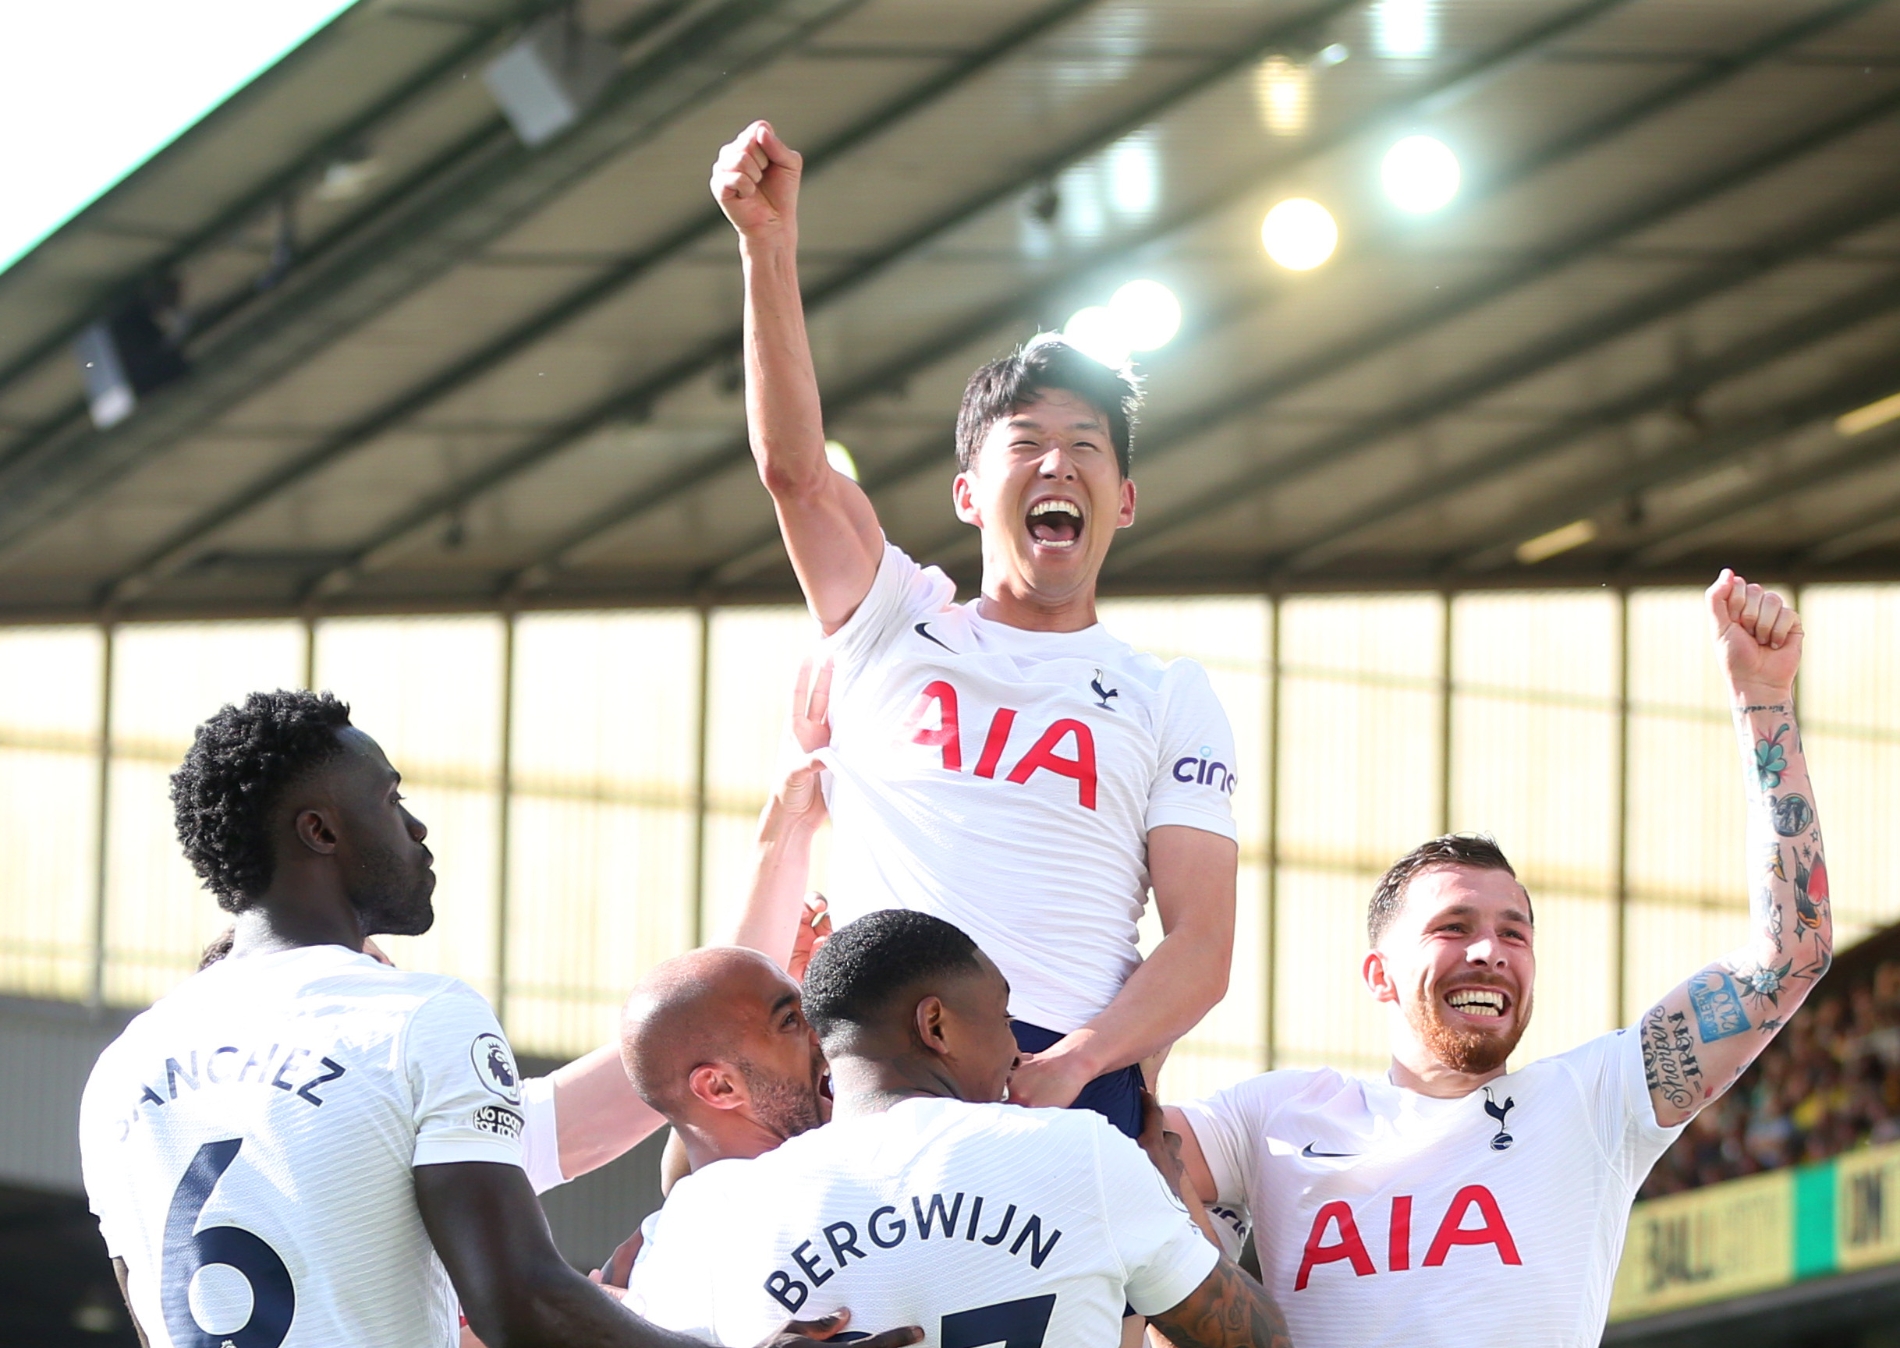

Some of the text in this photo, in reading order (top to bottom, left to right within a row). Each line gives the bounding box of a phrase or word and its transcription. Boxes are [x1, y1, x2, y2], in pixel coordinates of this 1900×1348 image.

[904, 680, 1097, 811] AIA
[763, 1191, 1063, 1314] BERGWIJN
[1294, 1184, 1523, 1292] AIA
